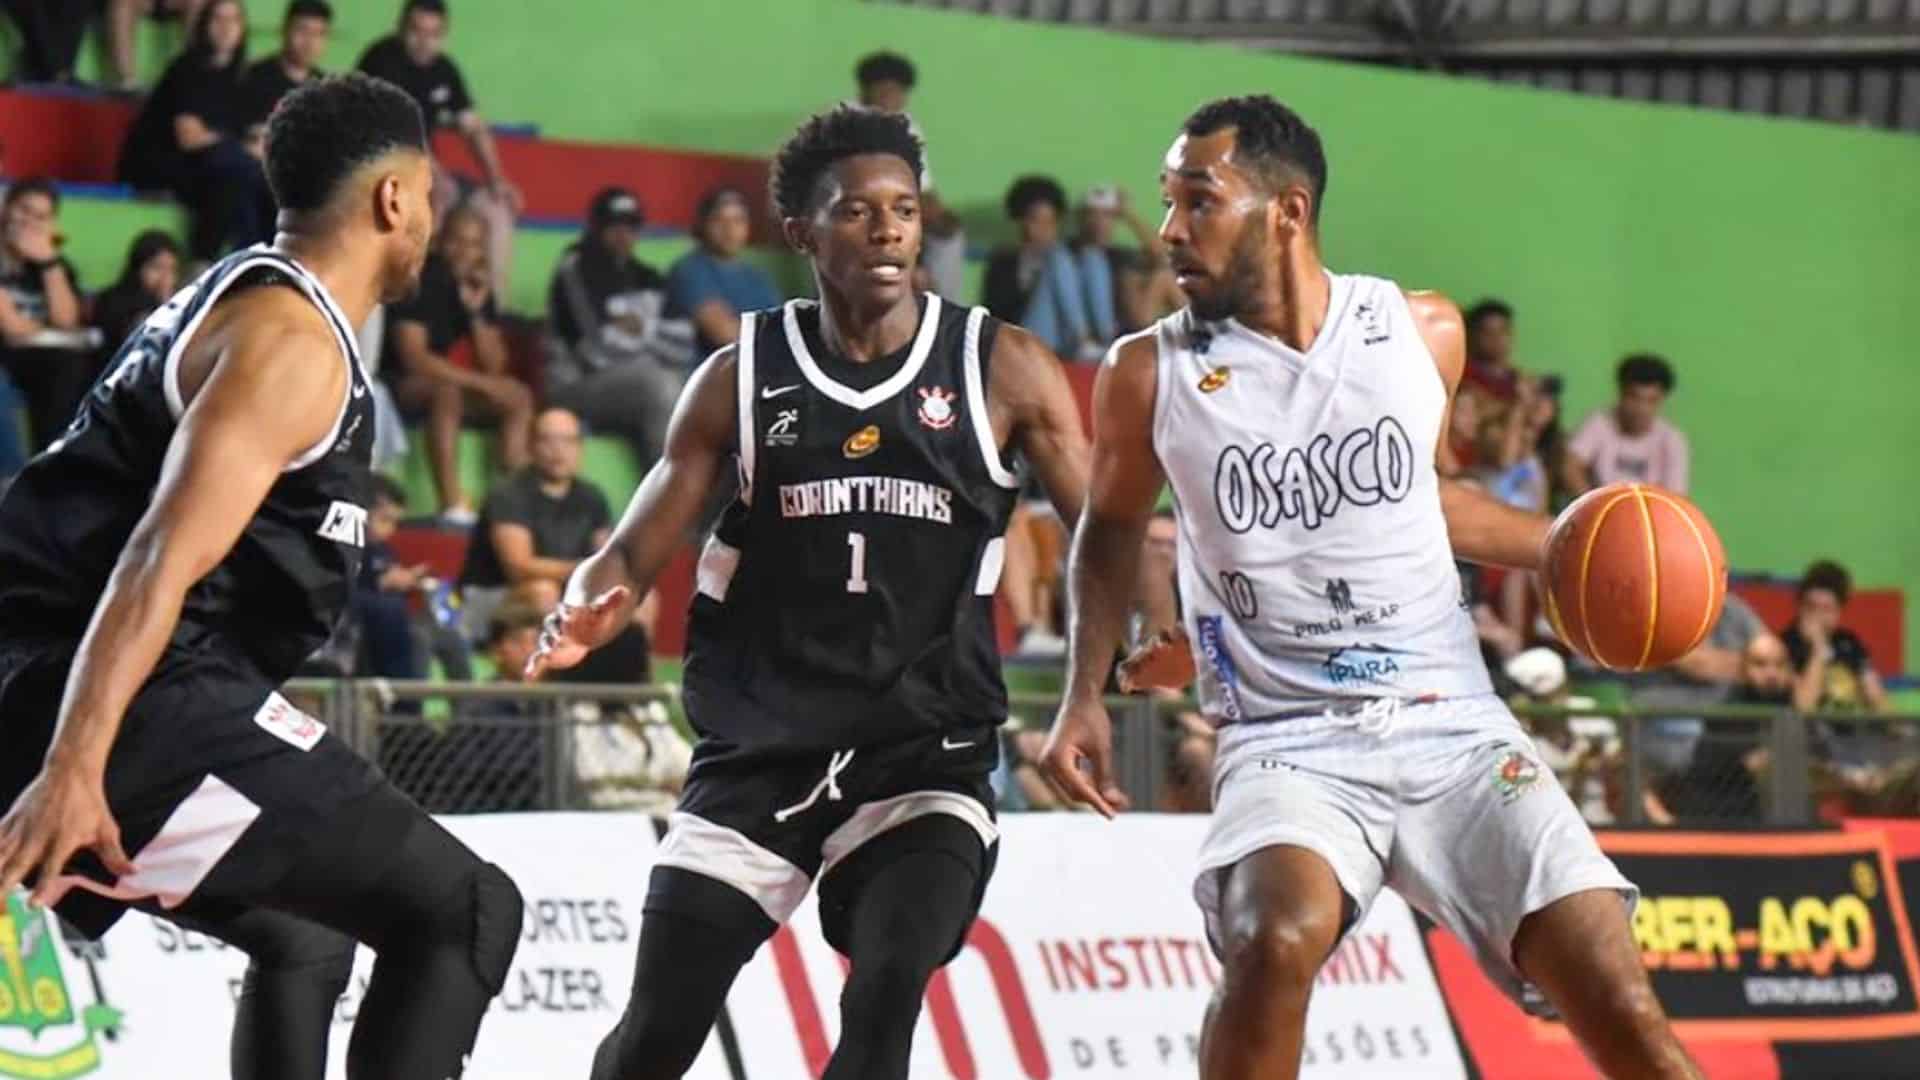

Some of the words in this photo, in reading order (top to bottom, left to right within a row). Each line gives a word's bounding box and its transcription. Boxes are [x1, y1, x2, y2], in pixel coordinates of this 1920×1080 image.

[1215, 416, 1413, 534] OSASCO
[779, 476, 952, 524] CORINTHIANS
[846, 531, 868, 593] 1
[1219, 571, 1258, 619] 10
[1294, 619, 1342, 638] POLO
[1354, 604, 1400, 627] WEAR
[502, 968, 613, 1011] LAZER
[1071, 1036, 1126, 1069] DE
